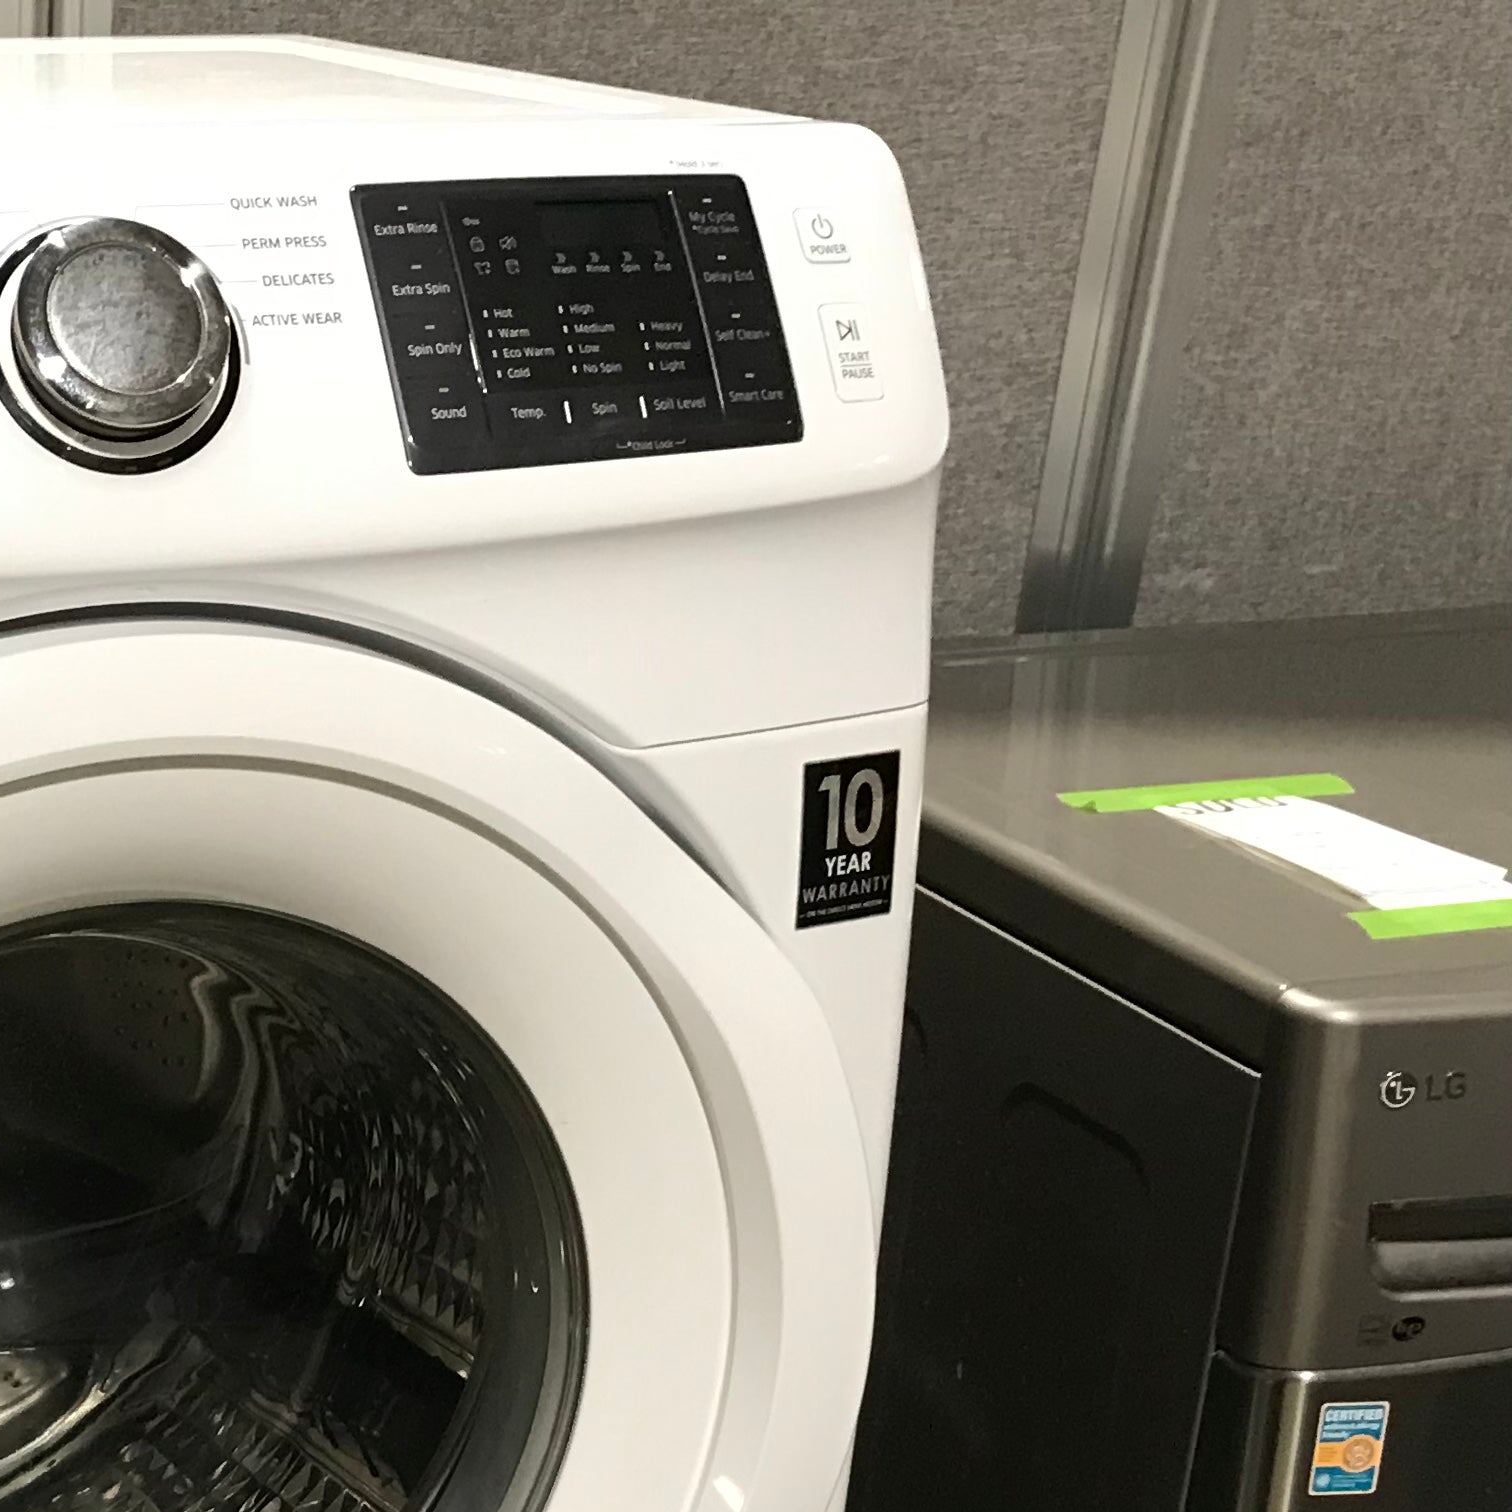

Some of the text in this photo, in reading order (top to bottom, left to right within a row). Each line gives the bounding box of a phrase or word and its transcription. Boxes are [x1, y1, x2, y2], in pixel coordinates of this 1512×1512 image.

[230, 195, 318, 210] QUICK WASH
[707, 211, 735, 224] Cycle
[374, 222, 438, 236] Extra Rinse
[242, 235, 327, 251] PERM PRESS
[810, 244, 847, 255] POWER
[262, 272, 335, 288] DELICATES
[703, 269, 754, 284] Delay End
[392, 282, 450, 297] Extra Spin
[493, 308, 514, 319] Hot
[569, 303, 594, 316] High
[251, 311, 343, 327] ACTIVE WEAR
[497, 327, 530, 338] Warm
[574, 322, 615, 333] Medium
[650, 321, 683, 333] Heavy
[715, 330, 734, 342] Self
[407, 343, 462, 357] Spin Only
[578, 343, 600, 353] Low
[655, 340, 691, 350] Normal
[503, 346, 555, 359] Eco Warm
[838, 351, 870, 363] START
[583, 361, 622, 374] No Spin
[659, 360, 685, 372] Light
[507, 367, 531, 379] Cold
[842, 367, 874, 379] PAUSE
[729, 389, 784, 402] Smart Care
[592, 402, 618, 415] Spin
[653, 397, 706, 411] Soil Level
[431, 406, 468, 419] Sound
[818, 768, 884, 850] 10
[825, 851, 872, 877] YEAR
[802, 874, 891, 904] WARRANTY
[1425, 1071, 1466, 1101] LG
